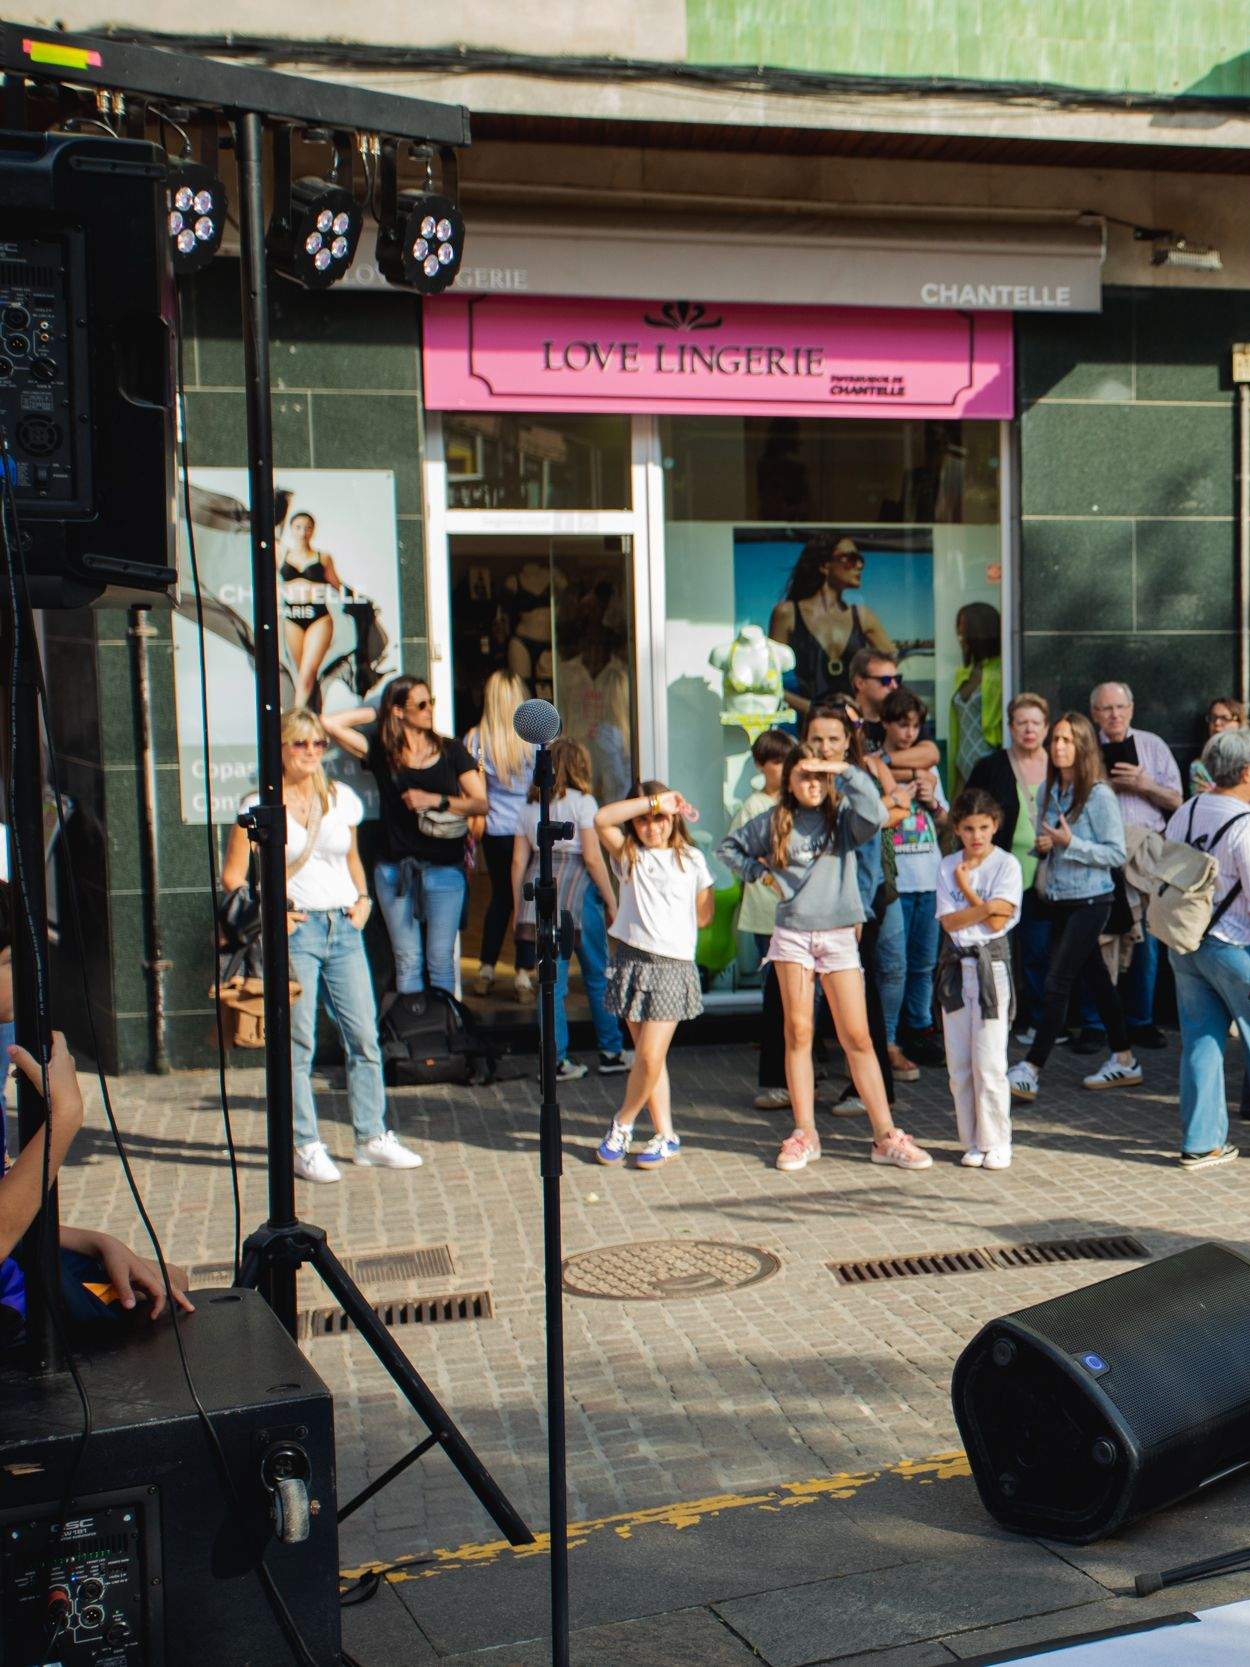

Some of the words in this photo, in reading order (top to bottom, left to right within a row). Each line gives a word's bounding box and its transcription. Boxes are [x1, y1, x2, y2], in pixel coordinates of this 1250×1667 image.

[920, 282, 1071, 306] CHANTELLE
[541, 340, 640, 372] LOVE
[655, 343, 825, 377] LINGERIE
[831, 385, 905, 396] CHANTELLE
[219, 583, 369, 605] CHNTELLE
